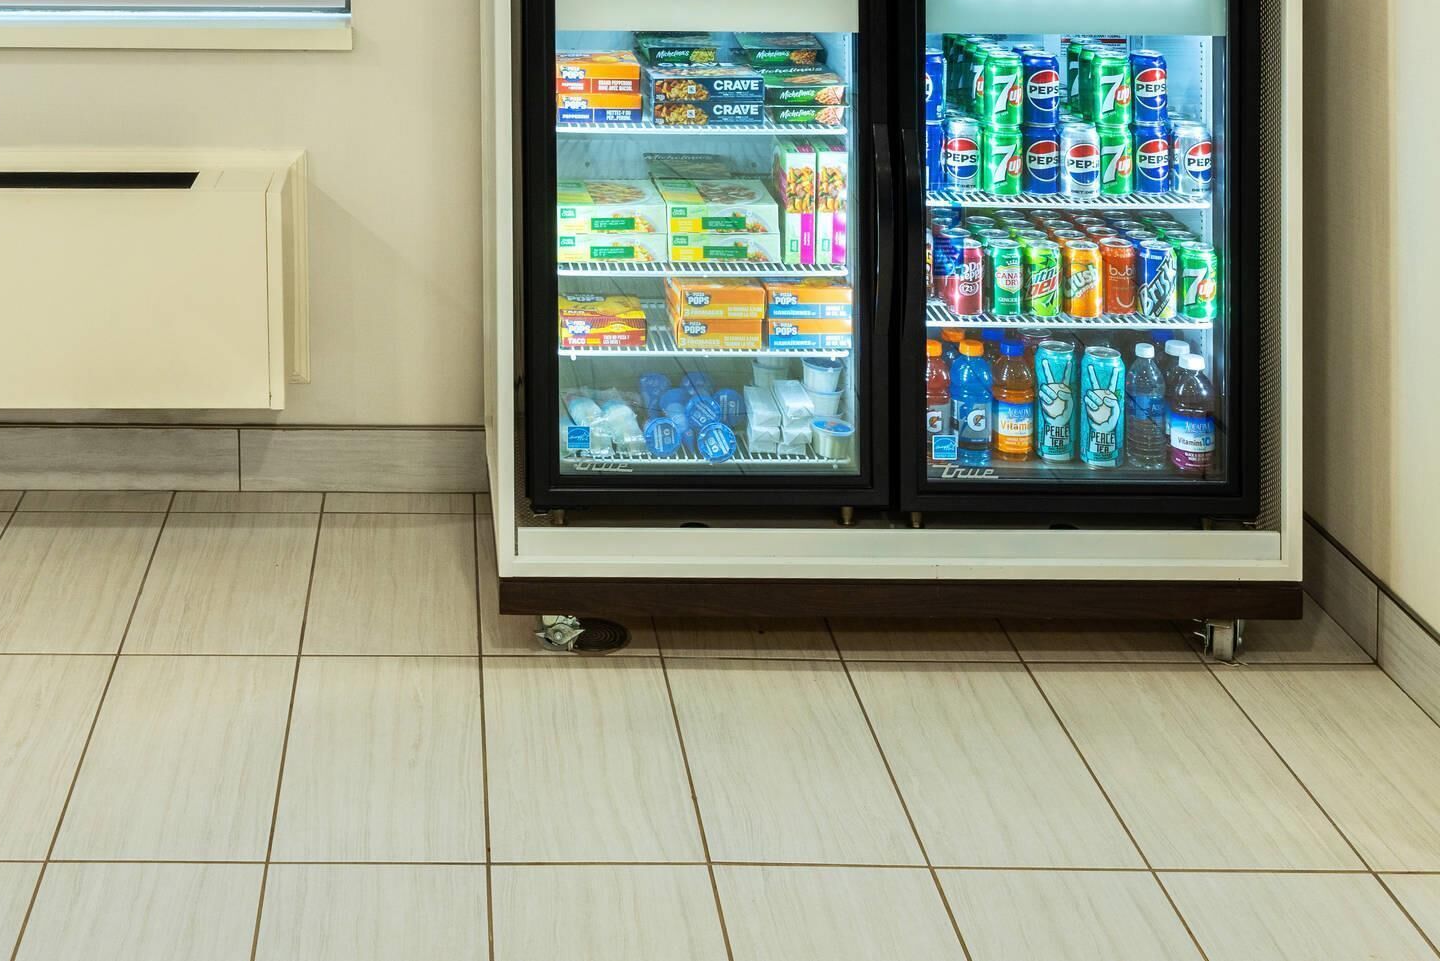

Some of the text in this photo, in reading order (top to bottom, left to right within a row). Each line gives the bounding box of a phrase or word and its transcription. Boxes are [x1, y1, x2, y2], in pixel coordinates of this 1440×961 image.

[713, 80, 759, 91] CRAVE
[713, 104, 759, 115] CRAVE
[687, 296, 710, 305] POPS
[775, 296, 798, 305] POPS
[568, 325, 591, 334] POPS
[684, 325, 706, 334] POPS
[775, 327, 798, 335] POPS
[967, 409, 986, 431] G
[1045, 425, 1070, 438] PEACE
[1091, 431, 1116, 444] PEACE
[932, 463, 999, 479] true
